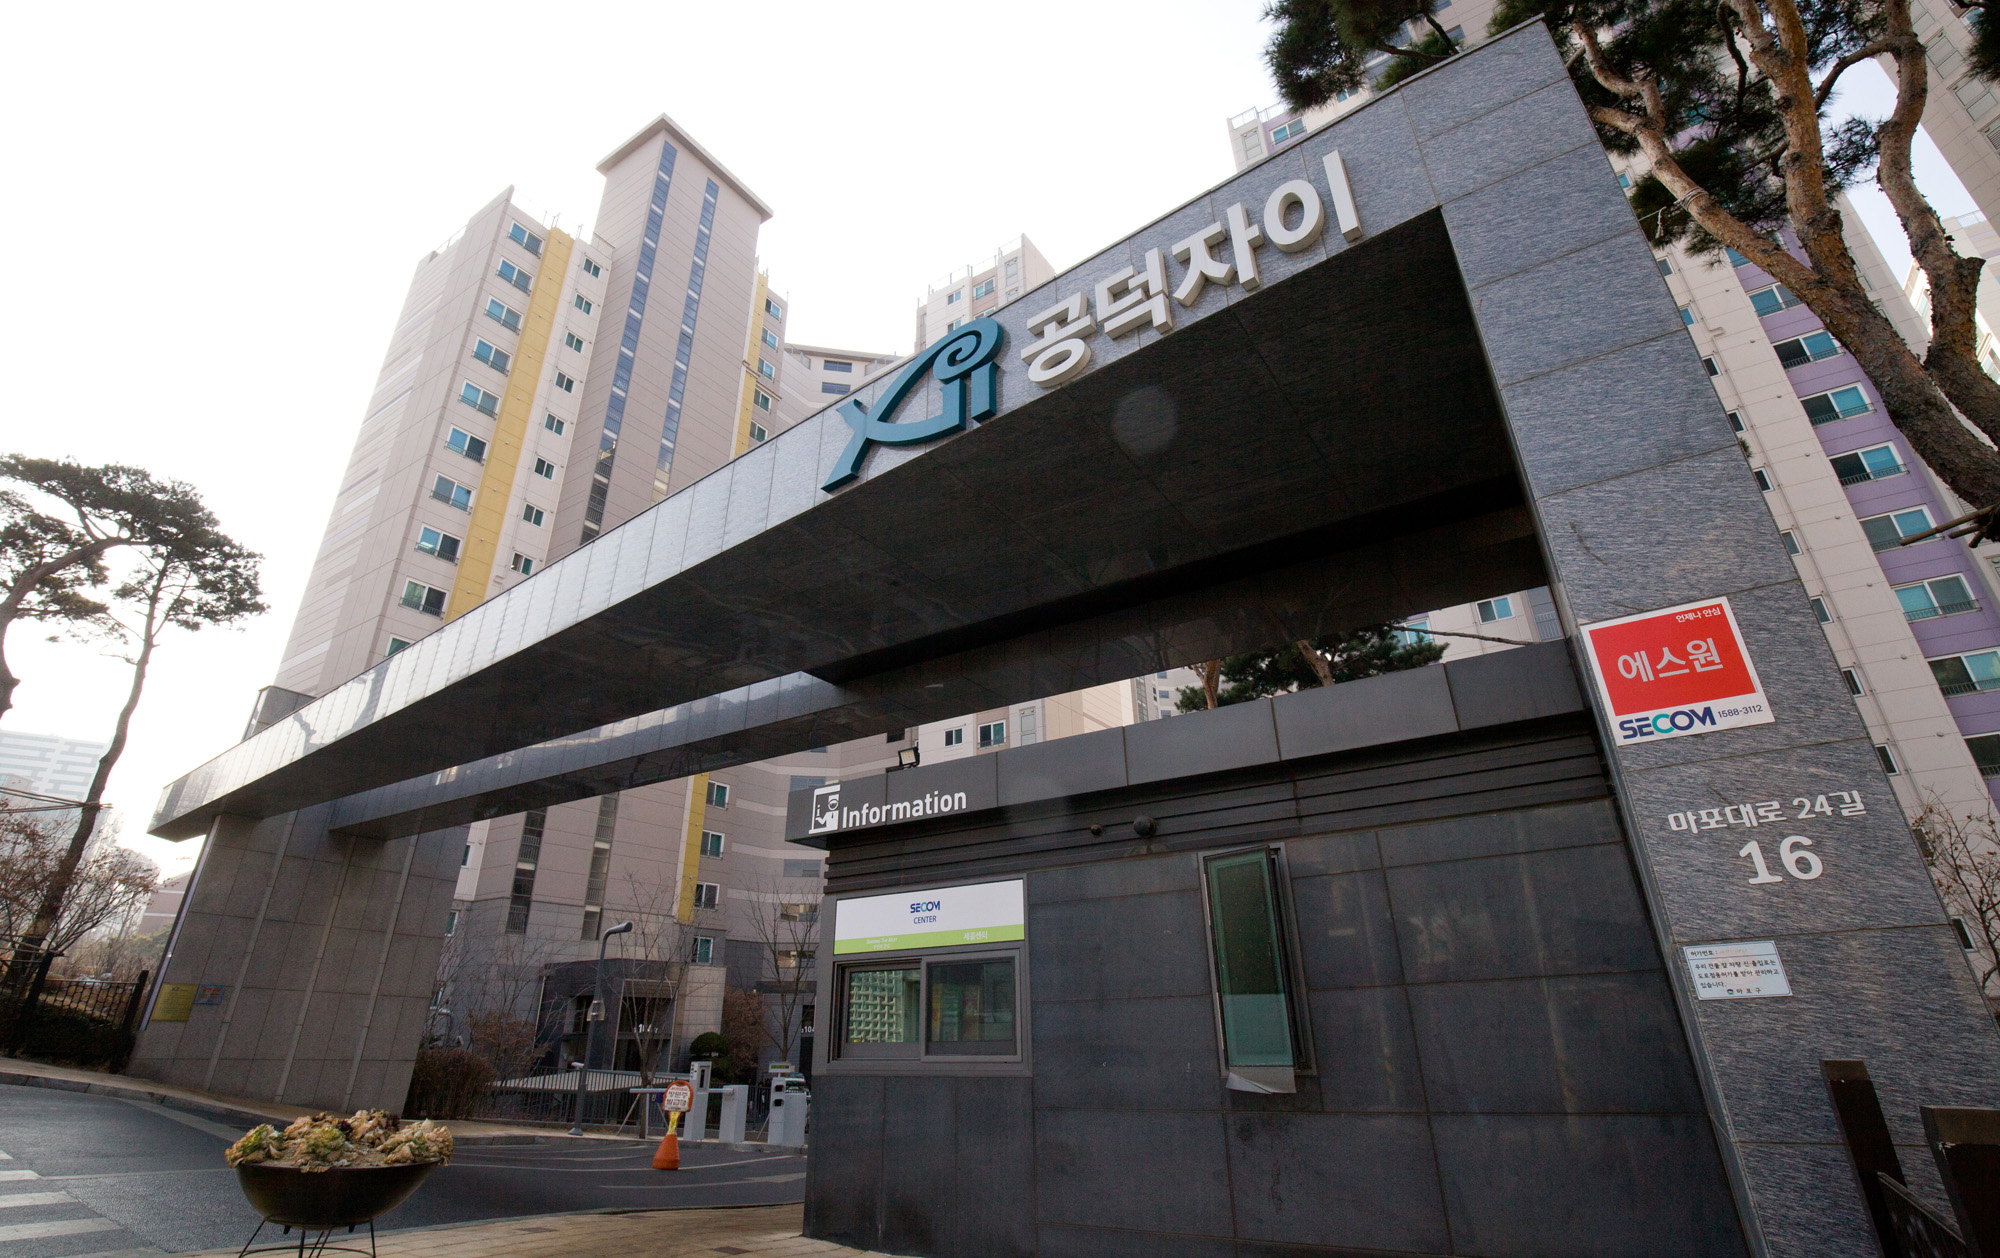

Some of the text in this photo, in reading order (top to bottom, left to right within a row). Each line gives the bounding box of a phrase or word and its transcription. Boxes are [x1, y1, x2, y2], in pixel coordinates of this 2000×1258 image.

[1021, 150, 1362, 388] 공덕자이
[1675, 606, 1721, 623] 언제나 안심
[1617, 638, 1723, 682] 에스원
[1618, 704, 1763, 740] SECOM 1588-3112
[842, 790, 967, 829] Information
[1667, 790, 1867, 834] 마포대로 24길
[1739, 835, 1823, 885] 16
[910, 900, 941, 914] SECOM
[913, 915, 937, 925] CENTER
